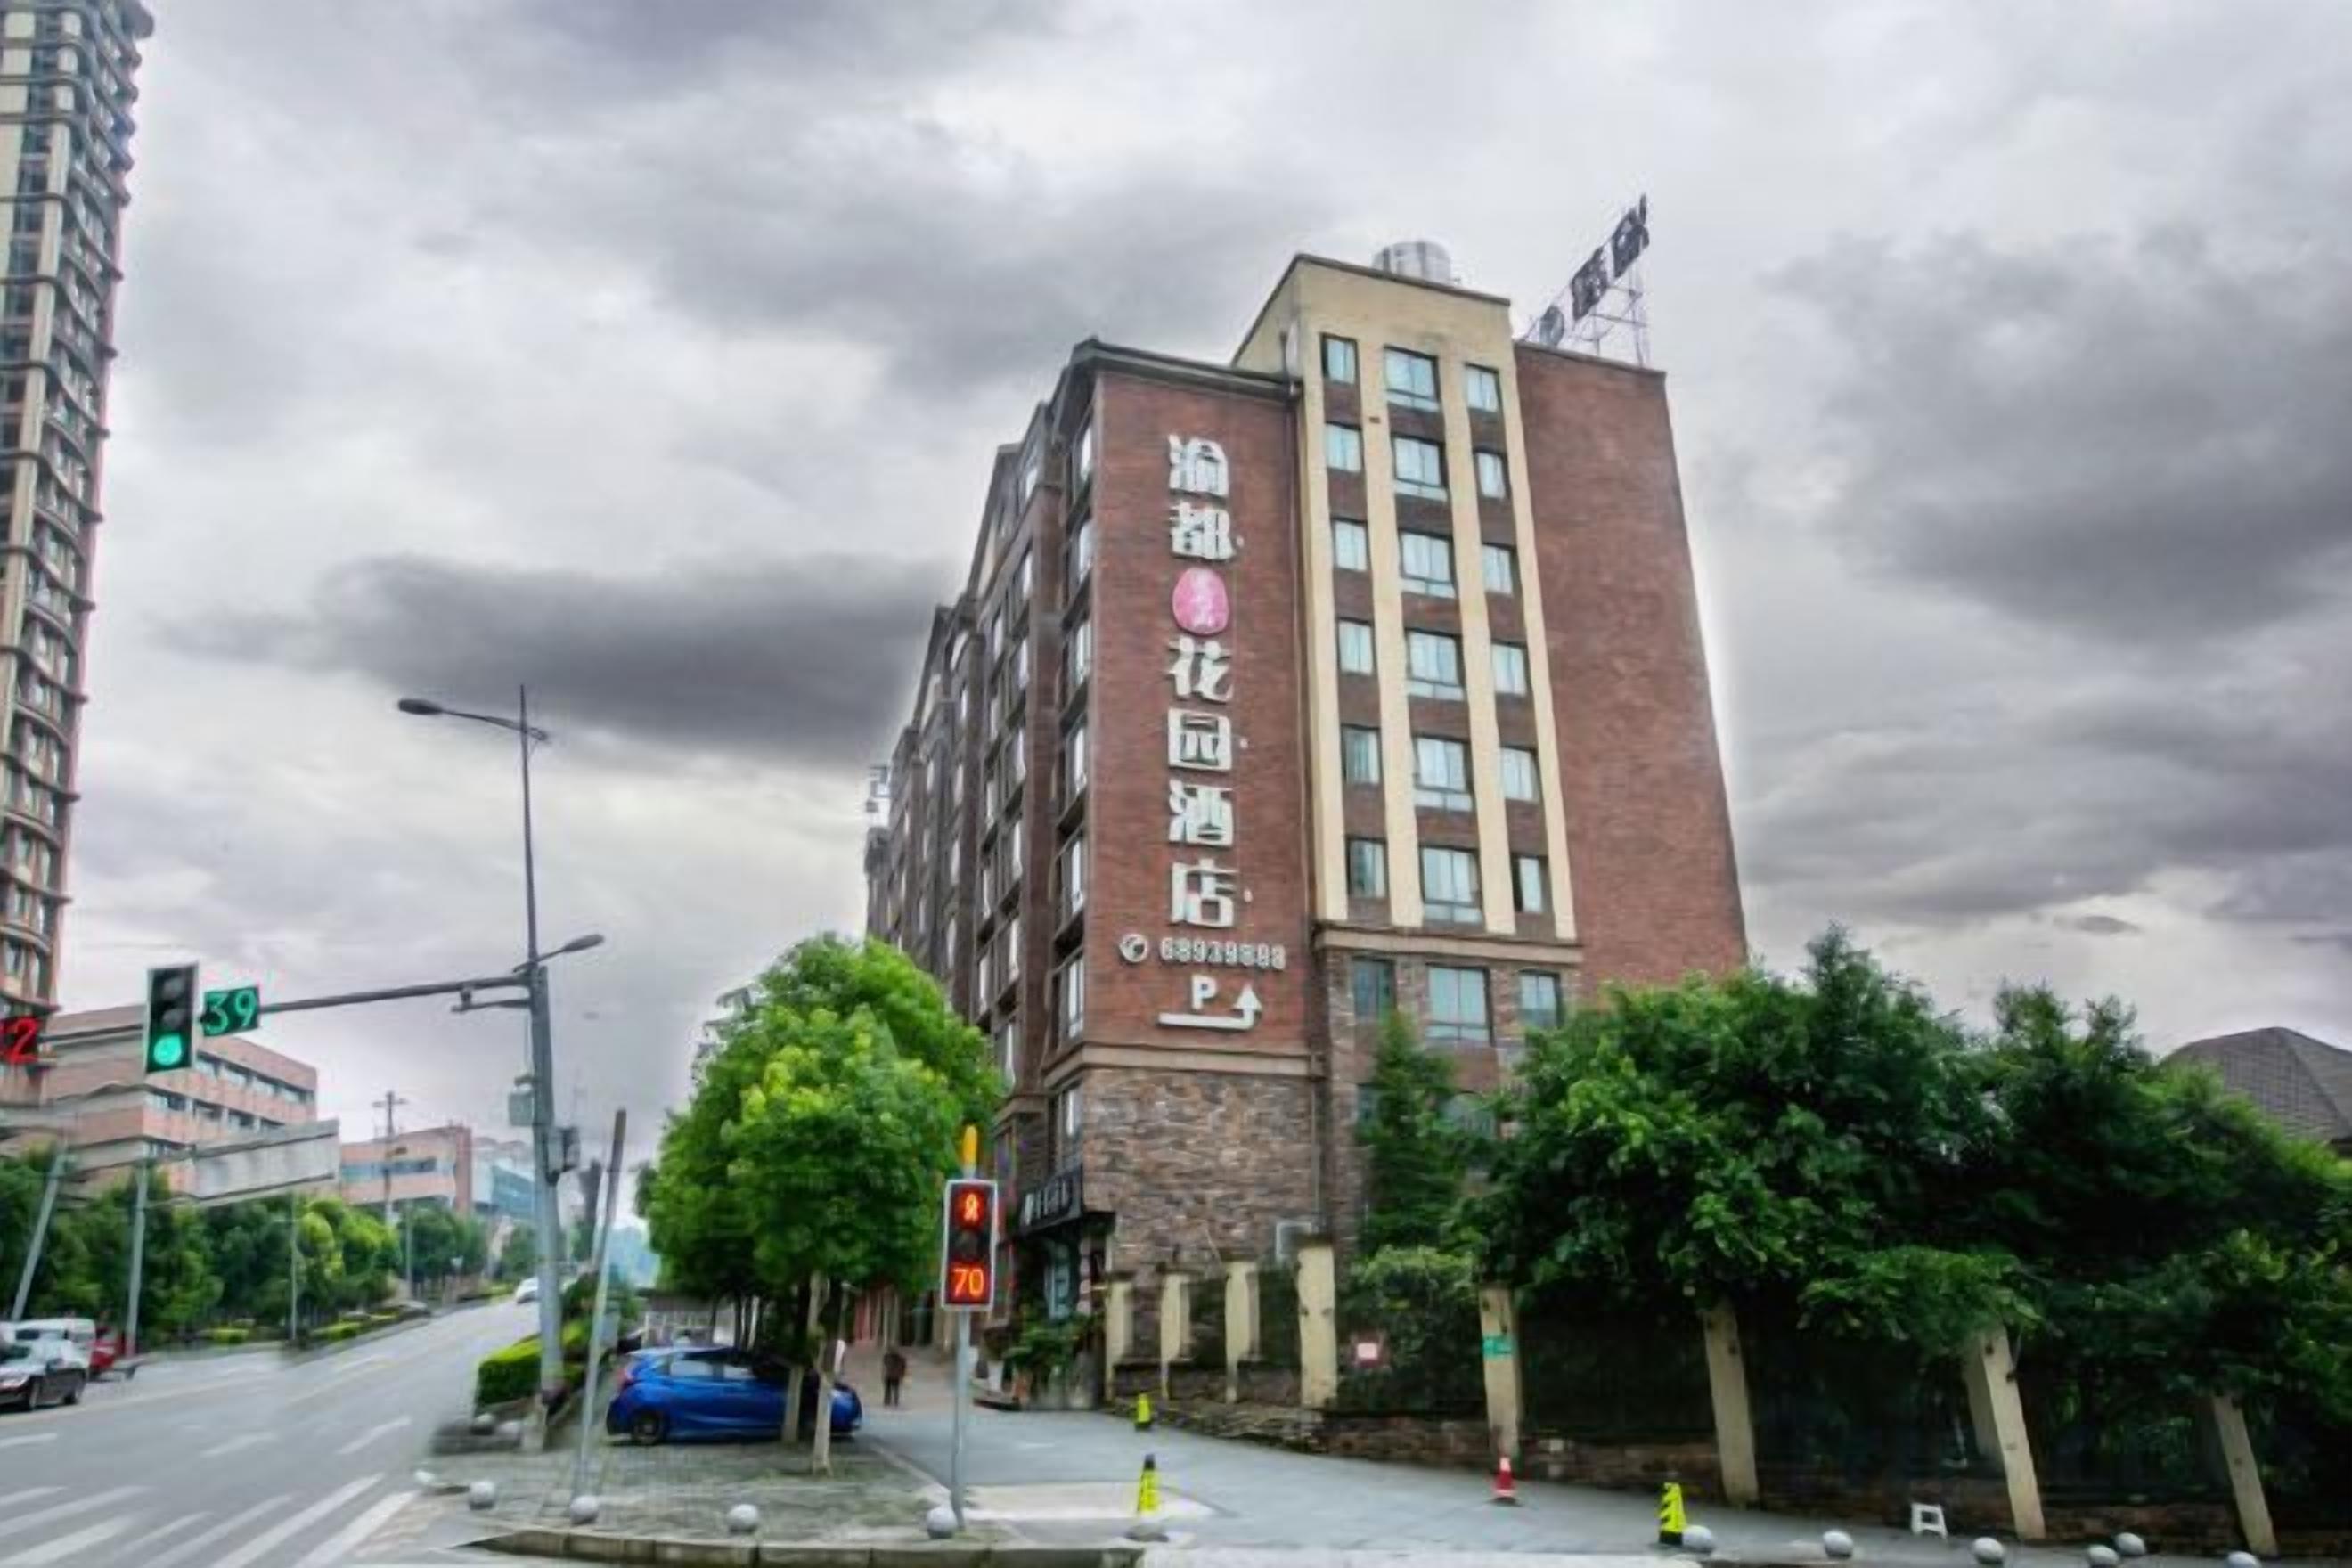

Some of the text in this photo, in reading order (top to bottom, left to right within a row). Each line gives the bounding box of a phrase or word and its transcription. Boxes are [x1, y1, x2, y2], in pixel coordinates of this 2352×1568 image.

[1191, 975, 1217, 1010] P
[203, 989, 257, 1035] 39
[952, 1268, 984, 1297] 70
